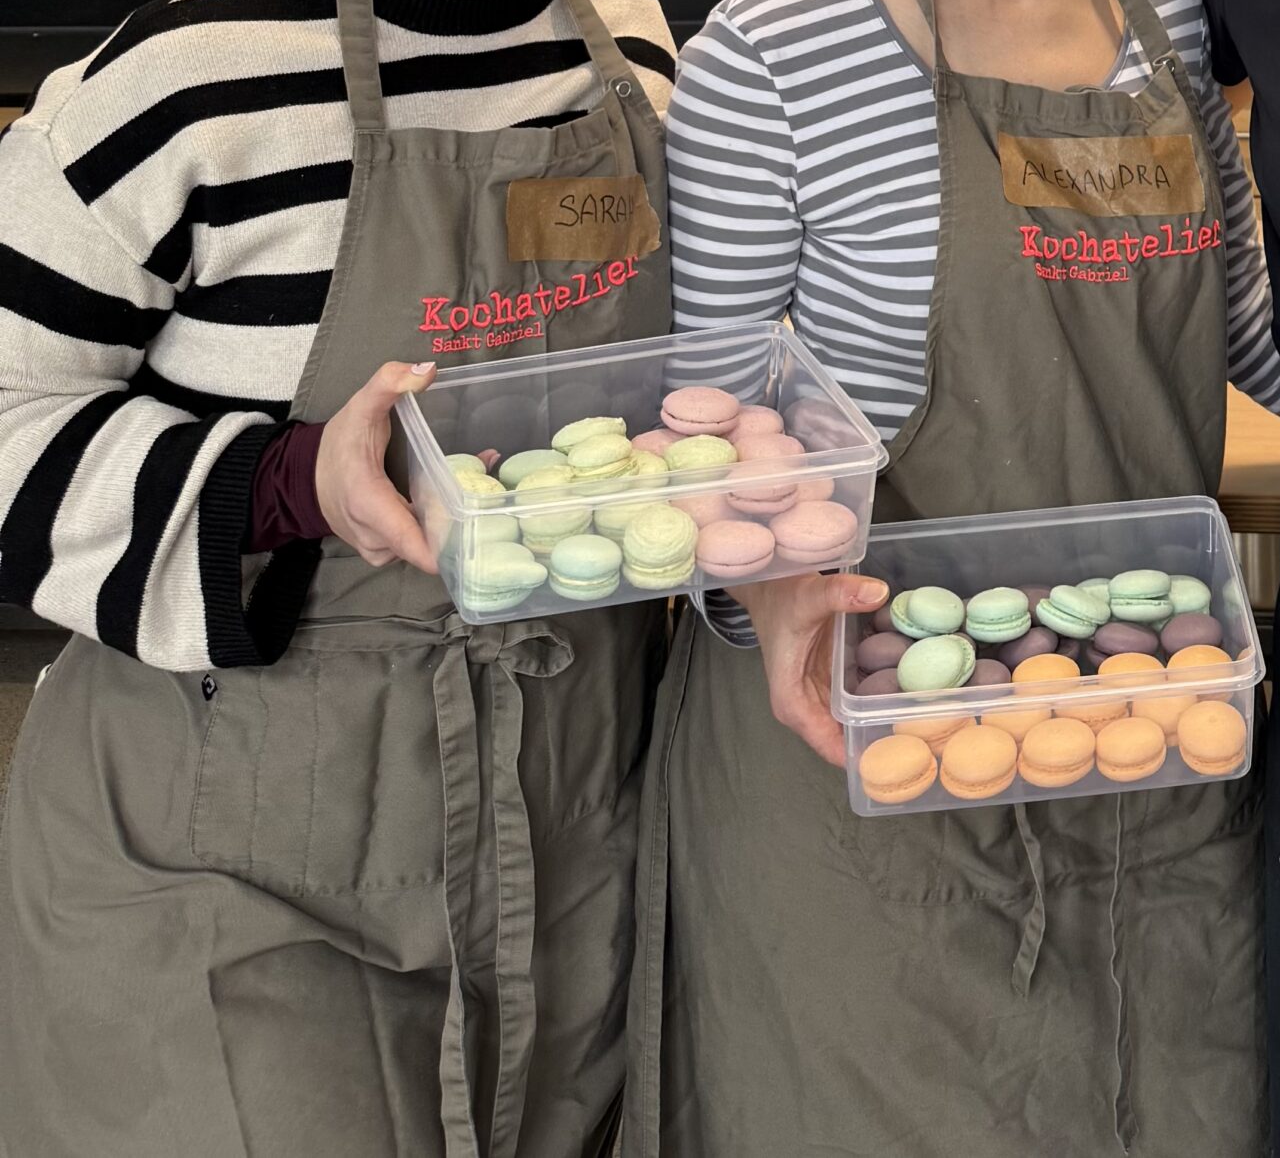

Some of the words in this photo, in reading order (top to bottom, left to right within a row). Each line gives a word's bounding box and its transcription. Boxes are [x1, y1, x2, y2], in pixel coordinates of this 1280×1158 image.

[1022, 160, 1171, 195] ALEXANDRA
[1019, 217, 1222, 264] Kochatelier
[1069, 265, 1131, 283] Gabriel
[419, 254, 640, 332] Kochatelier
[432, 333, 482, 353] Sankt
[486, 322, 545, 348] Gabriel
